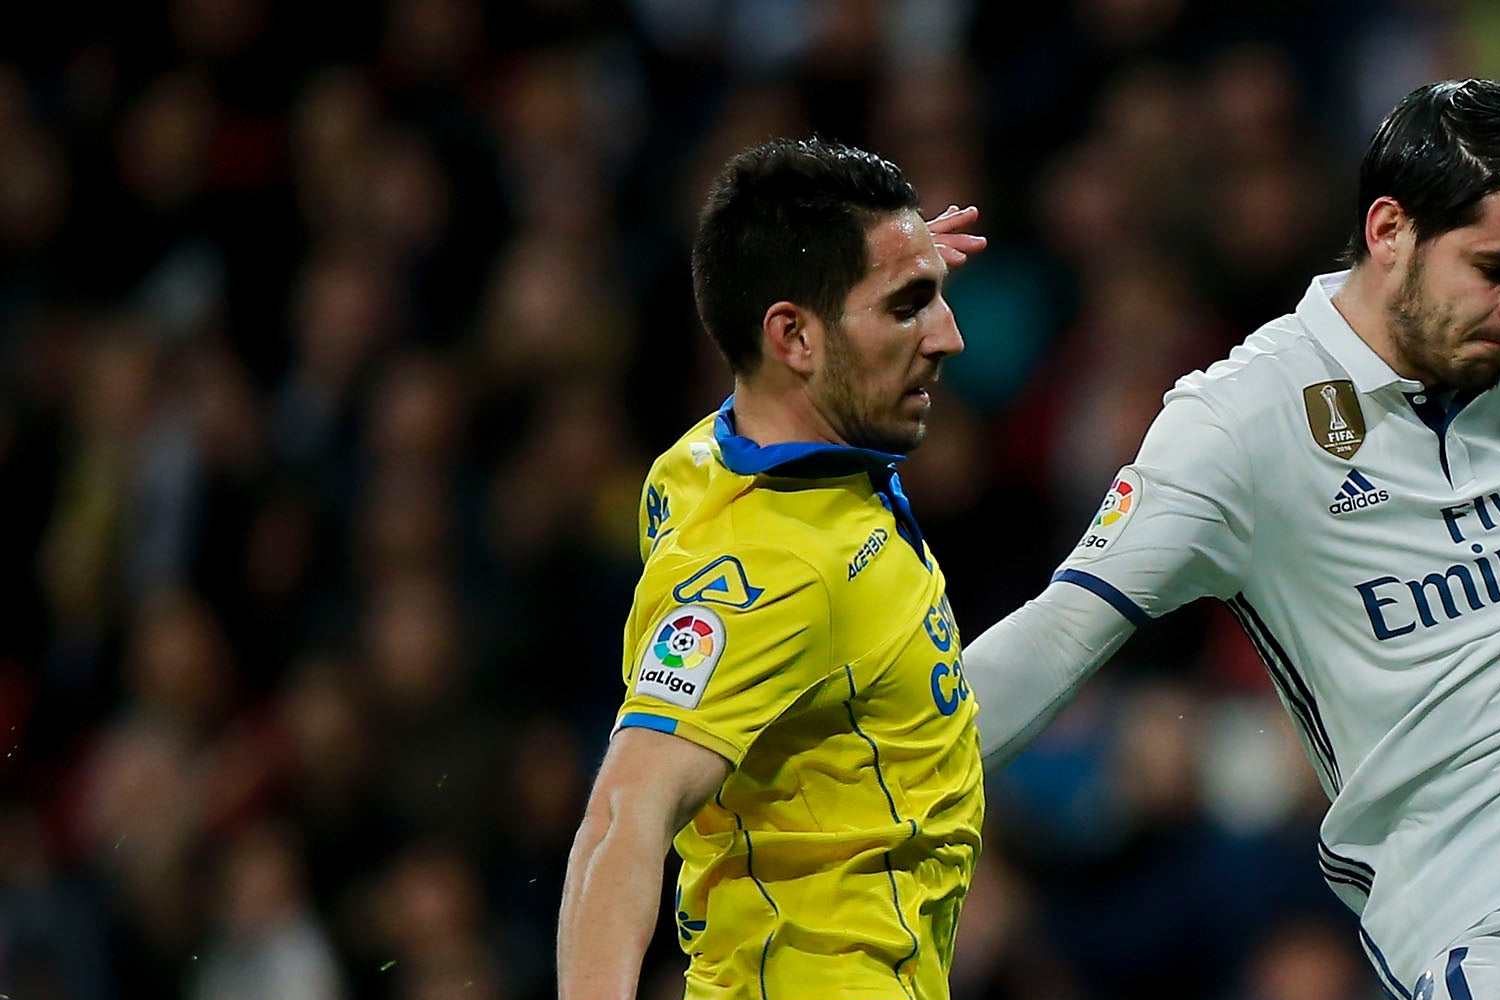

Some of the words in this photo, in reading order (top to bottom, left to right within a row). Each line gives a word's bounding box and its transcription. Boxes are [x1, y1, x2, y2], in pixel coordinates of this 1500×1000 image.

[1327, 430, 1355, 443] FIFA
[1329, 490, 1389, 514] adidas
[639, 668, 697, 695] LaLiga
